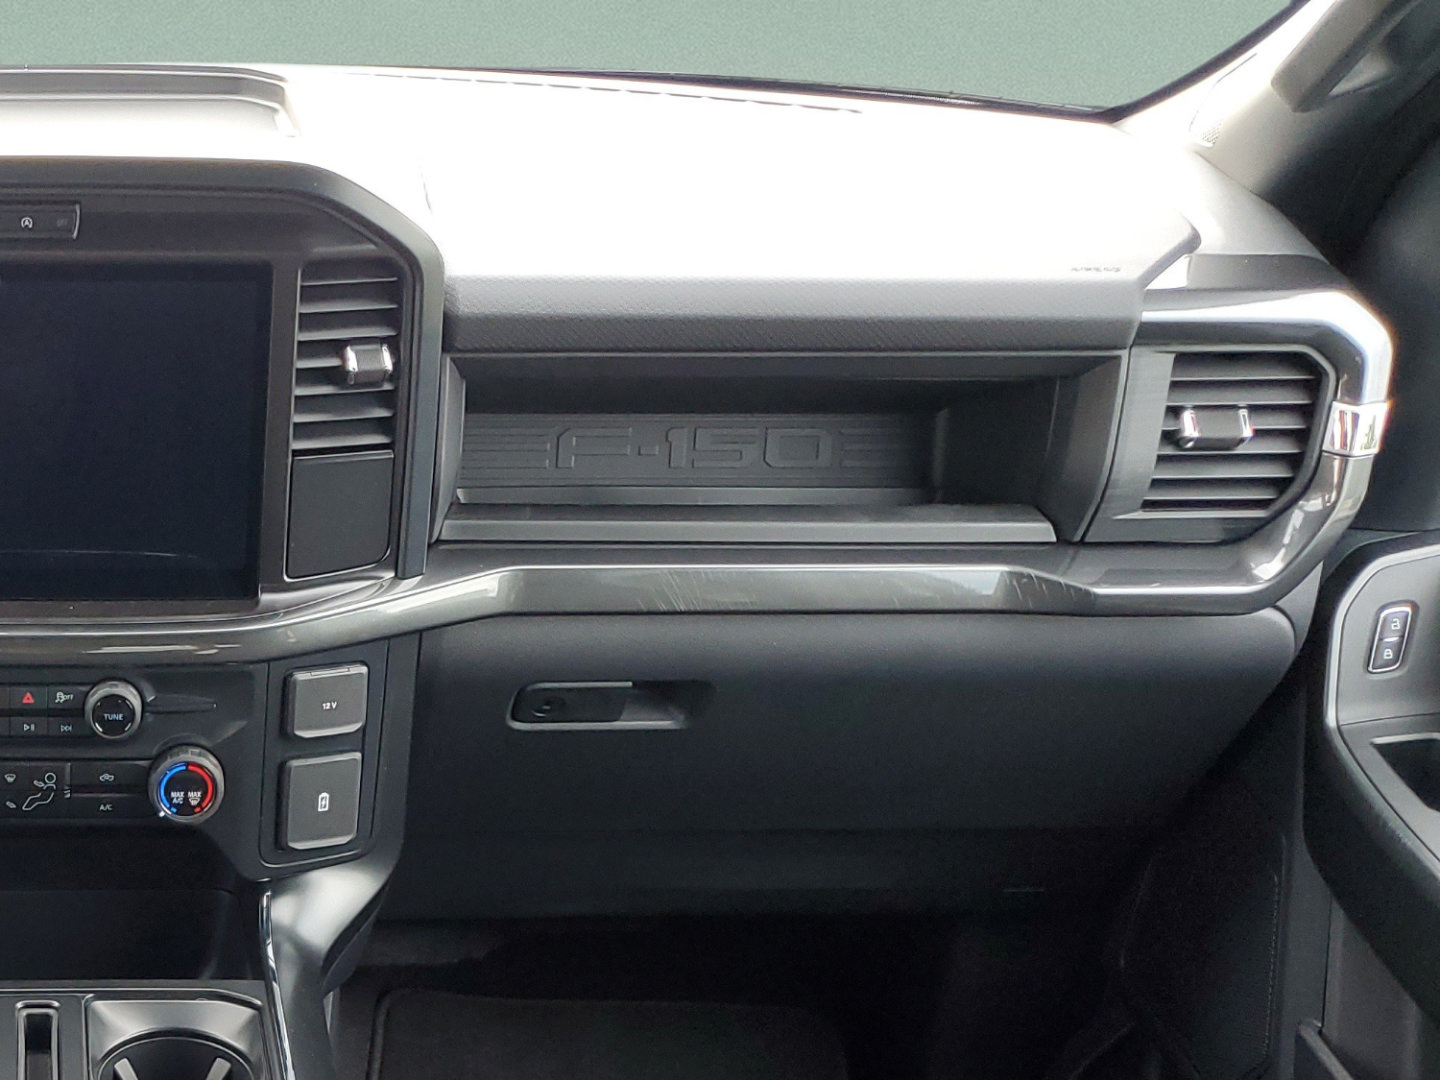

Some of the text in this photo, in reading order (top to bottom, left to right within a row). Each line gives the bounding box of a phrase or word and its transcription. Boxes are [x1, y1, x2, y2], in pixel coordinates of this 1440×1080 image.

[556, 426, 833, 469] F-150
[322, 702, 331, 710] 12
[103, 713, 124, 721] TUNE
[99, 803, 113, 811] A/C
